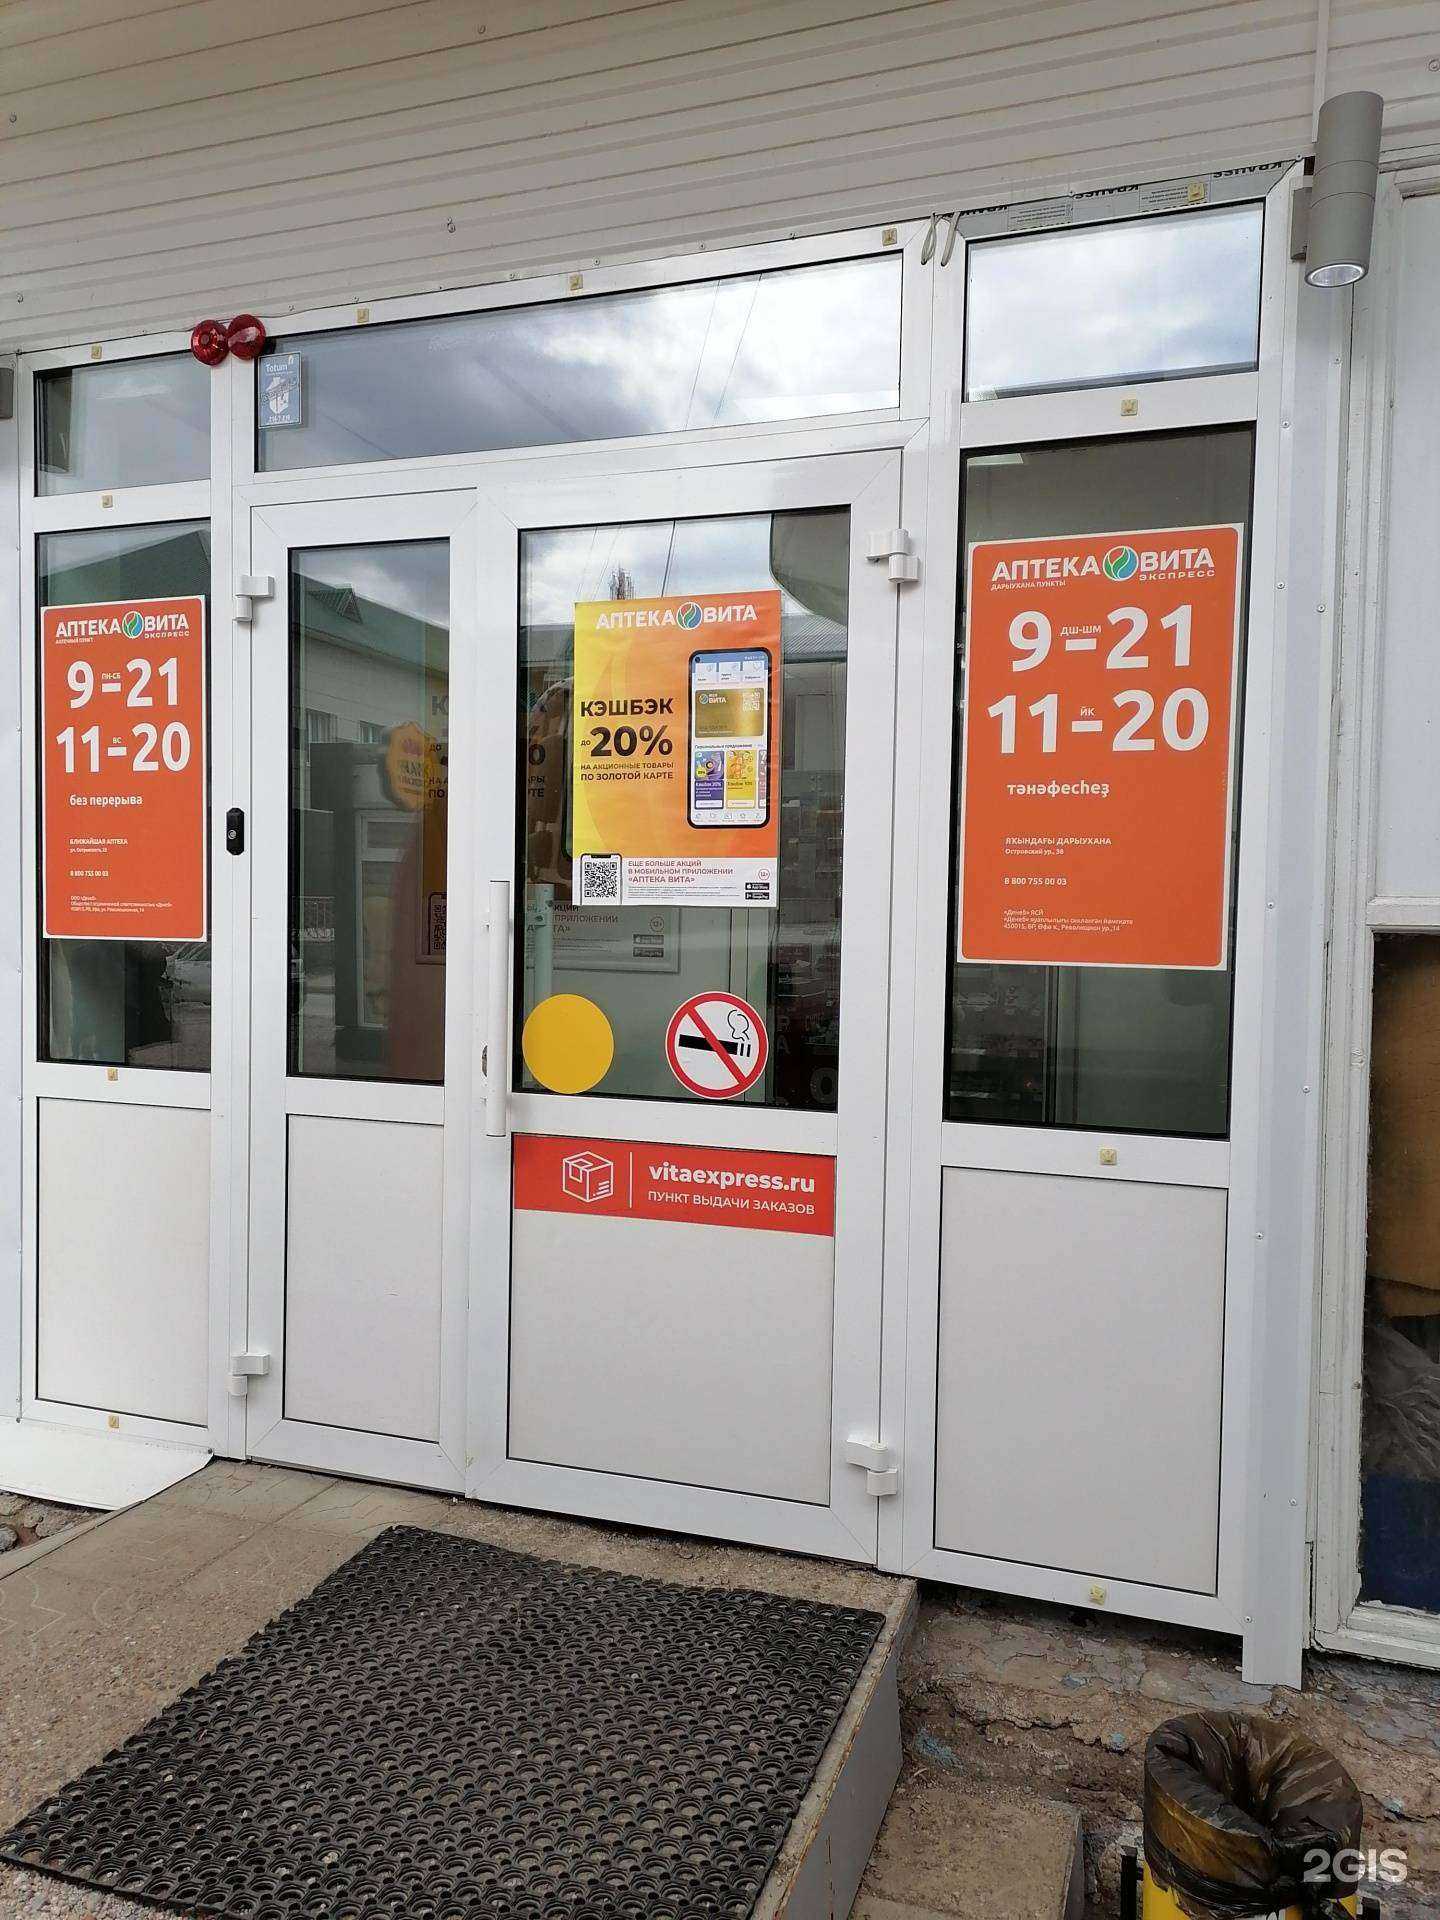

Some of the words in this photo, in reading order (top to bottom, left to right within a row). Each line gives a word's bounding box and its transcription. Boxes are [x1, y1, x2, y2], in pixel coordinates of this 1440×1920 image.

[991, 556, 1101, 582] АПТЕКА
[1140, 547, 1215, 572] ВИТА
[1139, 569, 1215, 582] ЭКСПРЕСС
[595, 608, 676, 630] АПТЕКА
[701, 604, 758, 623] ВИТА
[55, 618, 123, 638] АПТЕКА
[144, 613, 190, 632] ВИТА
[1060, 624, 1102, 637] ДШ-ШМ
[144, 630, 190, 639] ЭКСПРЕСС
[581, 697, 674, 717] КЭШБЭК
[1080, 706, 1096, 717] ЙК
[581, 738, 591, 747] до
[590, 725, 673, 757] 20%
[593, 761, 641, 769] АКЦИОННЫЕ
[642, 761, 674, 769] ТОВАРЫ
[581, 773, 594, 781] ПО
[596, 770, 641, 780] ЗОЛОТОЙ
[643, 771, 674, 780] КАРТЕ
[1007, 780, 1110, 798] тәнәфесһеҙ
[69, 794, 88, 806] без
[90, 795, 143, 808] перерыва
[1057, 837, 1112, 847] ДАРЫУХАНА
[676, 859, 702, 867] АКЦИЙ
[682, 867, 733, 875] ПРИЛОЖЕНИИ
[1004, 877, 1010, 885] 8
[1011, 877, 1027, 885] 800
[1028, 877, 1043, 886] 755
[1057, 878, 1067, 886] 03
[648, 1161, 815, 1192] vitaexpress.ru
[648, 1190, 690, 1205] ПУНКТ
[693, 1194, 750, 1209] ВЫДАЧИ
[753, 1198, 815, 1215] ЗАКАЗОВ
